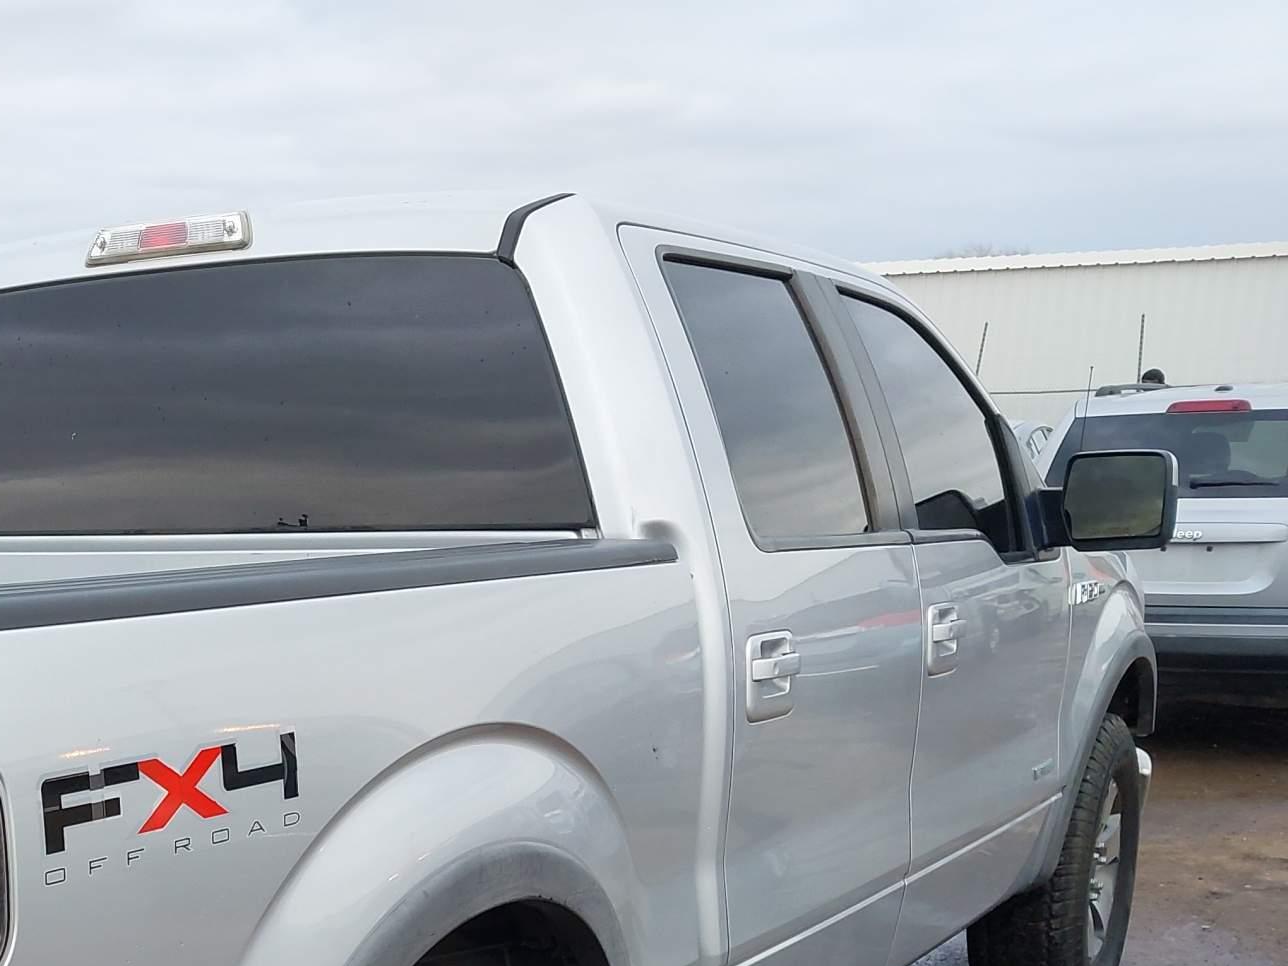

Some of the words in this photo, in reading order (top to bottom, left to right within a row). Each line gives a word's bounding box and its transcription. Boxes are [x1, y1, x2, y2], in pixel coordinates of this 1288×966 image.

[40, 731, 300, 856] FX4
[44, 848, 145, 886] OFF
[174, 811, 301, 855] ROAD
